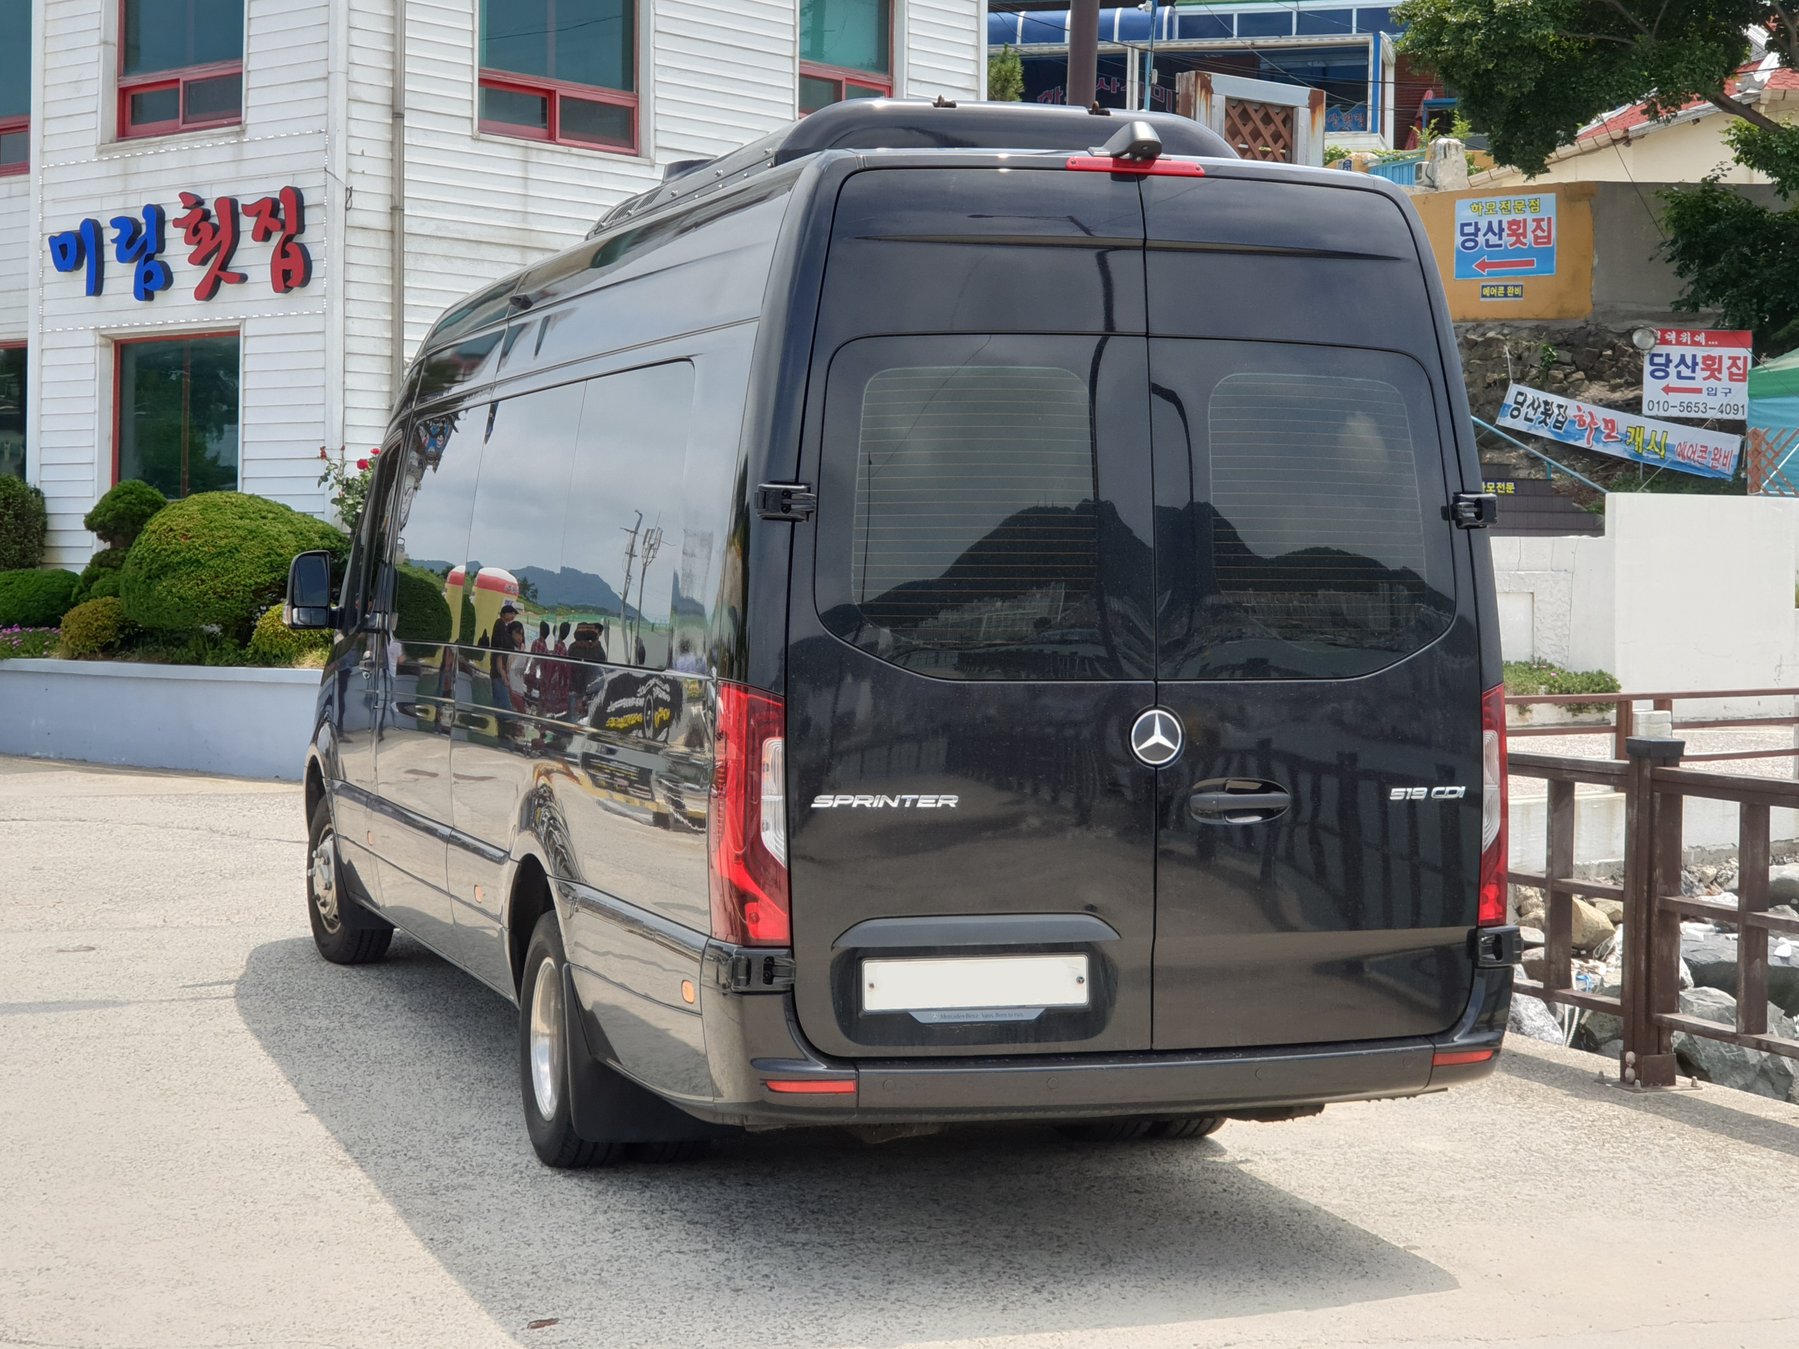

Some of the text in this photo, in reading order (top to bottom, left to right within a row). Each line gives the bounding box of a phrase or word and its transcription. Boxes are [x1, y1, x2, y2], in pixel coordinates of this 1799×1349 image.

[1470, 198, 1541, 216] 하모전문점
[1459, 216, 1554, 252] 당산횟집
[1482, 286, 1522, 297] 에어콘 완비
[1648, 352, 1748, 383] 당산횟집
[1706, 386, 1732, 397] 입구
[1647, 400, 1746, 416] 010-5653-4091
[1510, 390, 1568, 431] 당산횟집
[1573, 404, 1621, 446] 하모
[1625, 425, 1668, 460] 개시
[810, 794, 959, 808] SPRINTER
[1389, 786, 1466, 801] 519 CDI
